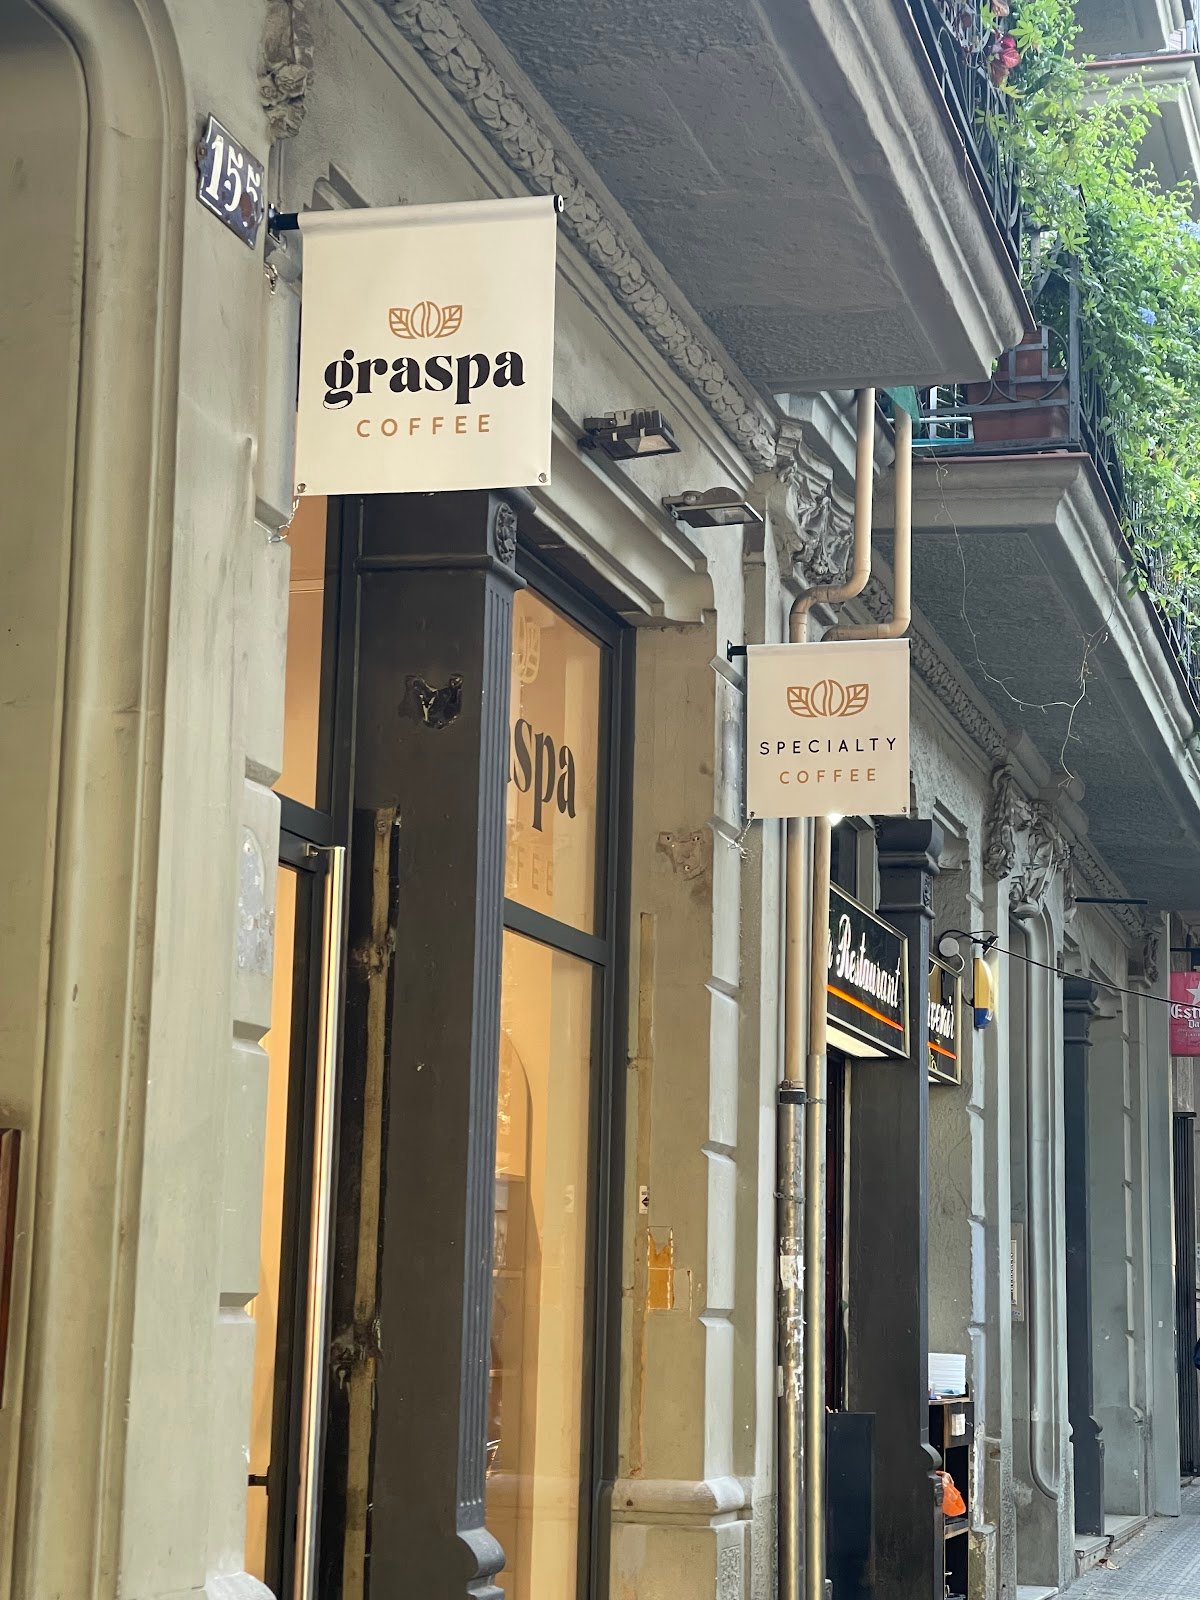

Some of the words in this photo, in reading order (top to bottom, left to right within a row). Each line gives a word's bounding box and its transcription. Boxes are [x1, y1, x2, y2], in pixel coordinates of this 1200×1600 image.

[322, 349, 526, 410] graspa
[356, 414, 491, 438] COFFEE
[759, 737, 897, 756] SPECIALTY
[779, 768, 877, 785] COFFEE
[835, 913, 901, 1008] Restaurant
